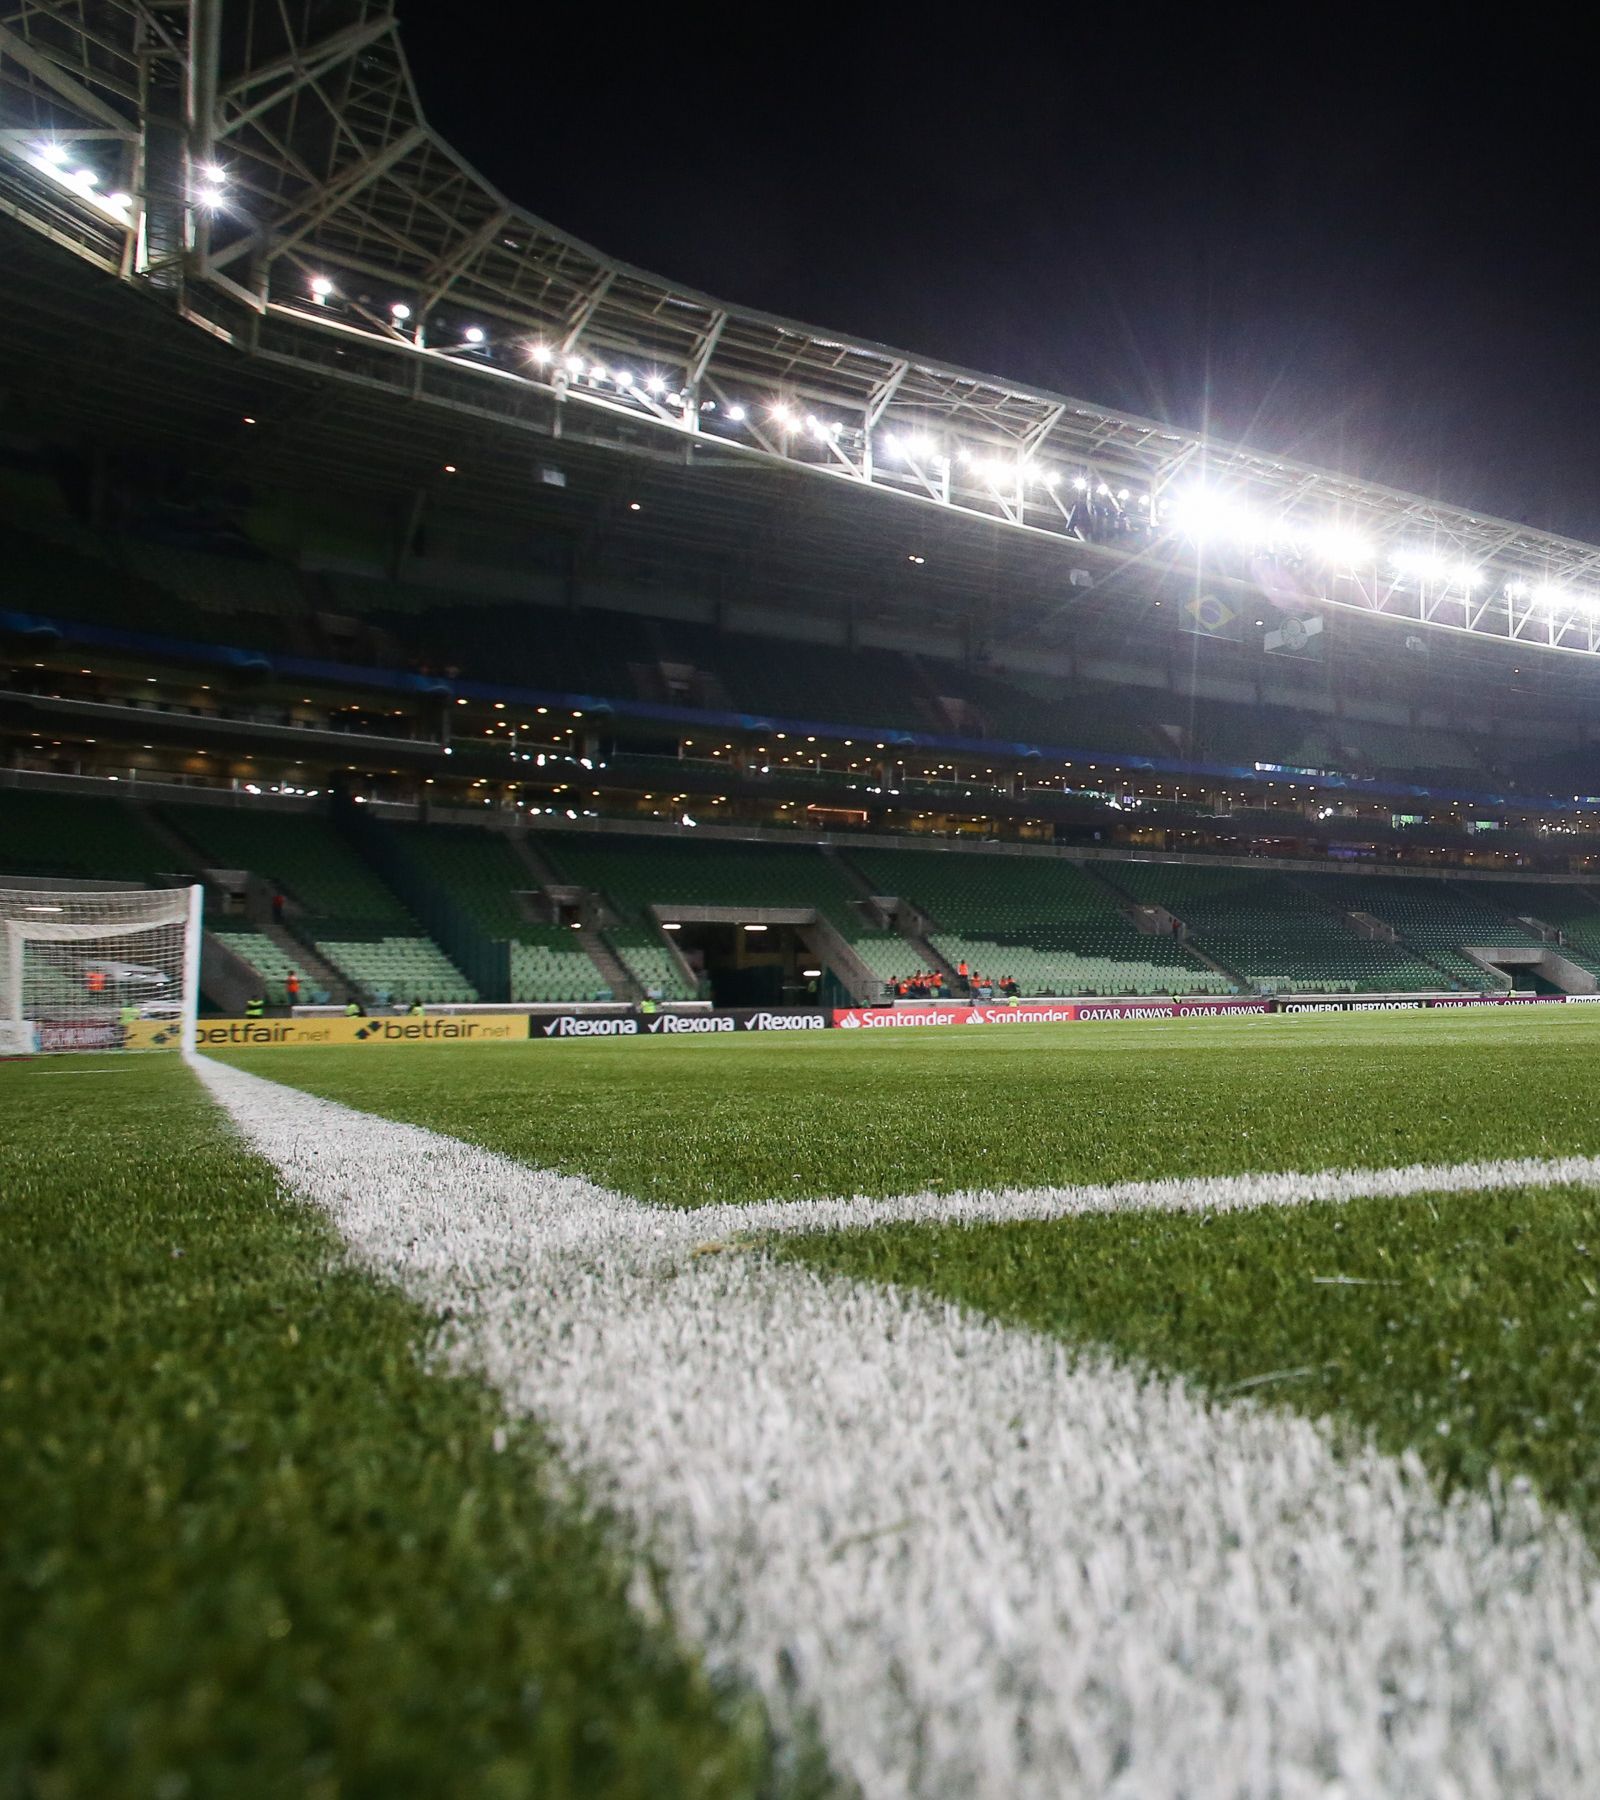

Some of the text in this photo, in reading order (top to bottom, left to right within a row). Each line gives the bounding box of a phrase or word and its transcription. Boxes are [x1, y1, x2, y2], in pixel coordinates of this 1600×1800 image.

[862, 1011, 955, 1028] Santander
[985, 1009, 1069, 1023] Santander
[1080, 1008, 1173, 1020] QATAR AIRWAYS
[1180, 1006, 1264, 1017] QATAR AIRWAYS
[560, 1017, 637, 1035] Rexona
[663, 1015, 734, 1033] Rexona
[759, 1013, 824, 1030] Rexona
